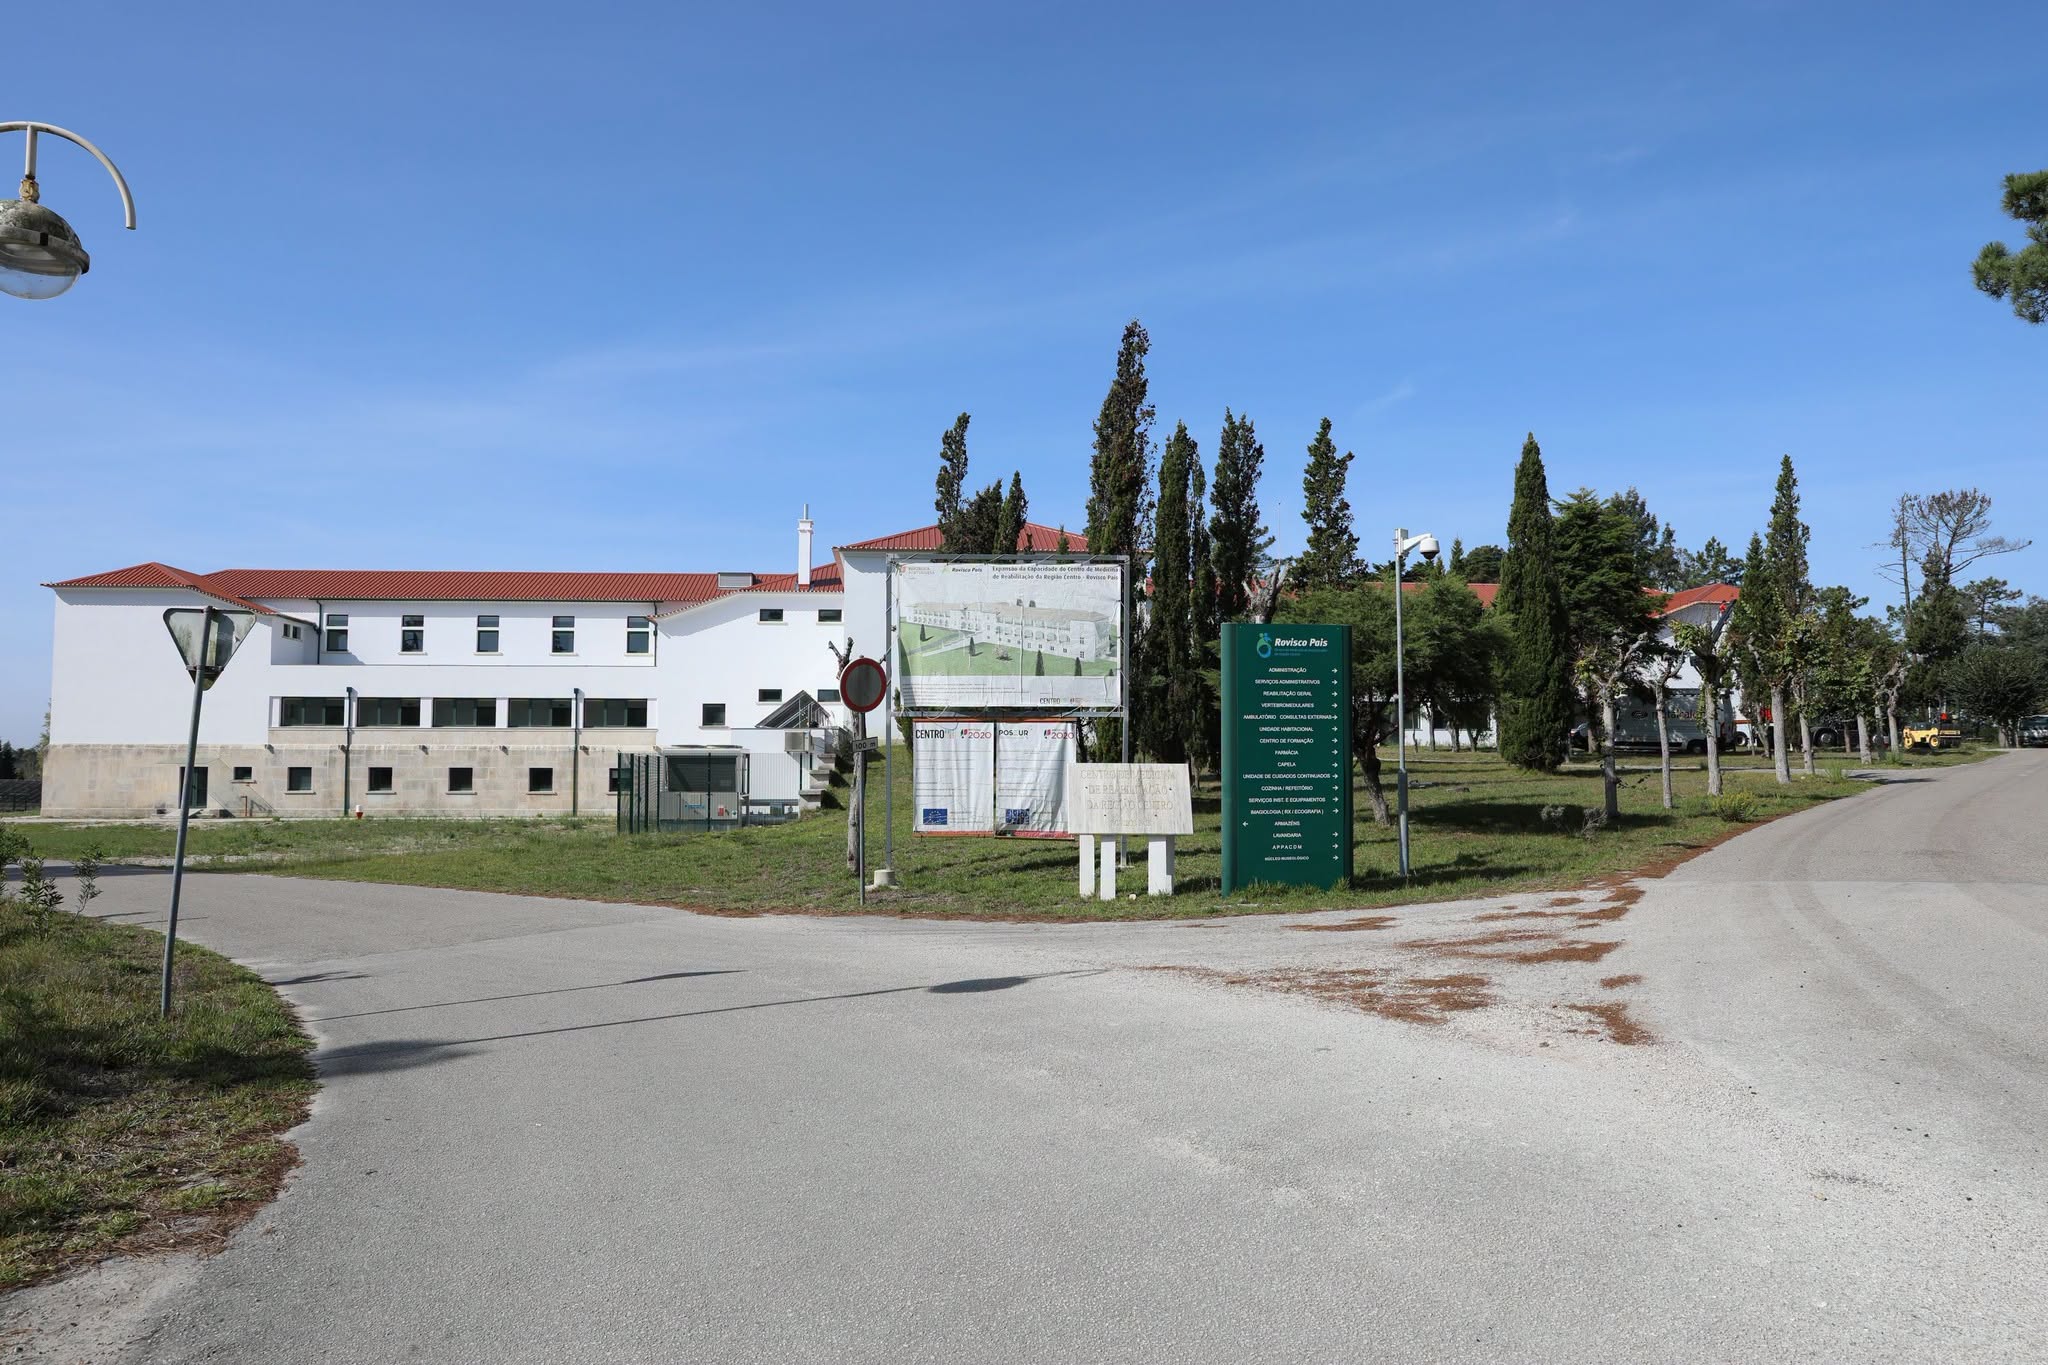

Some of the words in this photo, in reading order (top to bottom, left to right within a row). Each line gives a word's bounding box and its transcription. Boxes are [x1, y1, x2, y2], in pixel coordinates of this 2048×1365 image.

[1274, 638, 1307, 647] Rovisco
[1309, 638, 1328, 647] Pais
[915, 729, 945, 739] CENTRO
[968, 731, 992, 739] 2020
[1051, 731, 1075, 739] 2020
[1080, 769, 1116, 779] CENTRO
[1120, 769, 1131, 779] DE
[1088, 785, 1101, 795] DE
[1086, 800, 1099, 809] DA
[1102, 798, 1136, 810] REGIÃO
[1137, 800, 1173, 810] CENTRO
